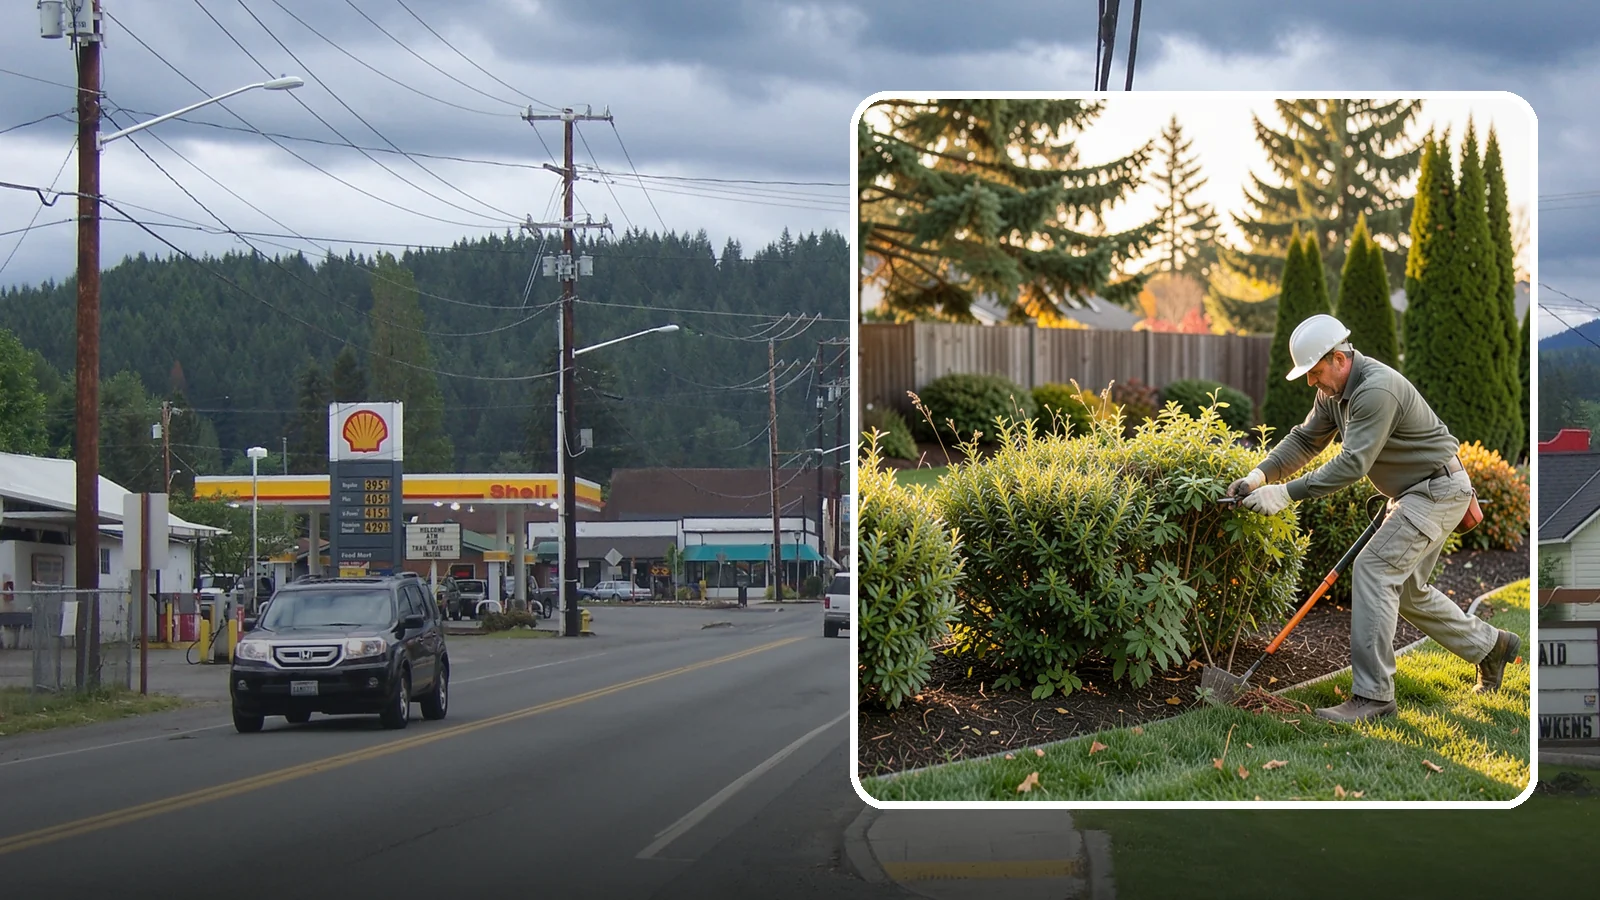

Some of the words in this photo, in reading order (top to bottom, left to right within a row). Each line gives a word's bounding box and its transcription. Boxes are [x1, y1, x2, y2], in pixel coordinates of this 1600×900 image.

[366, 480, 383, 490] 395
[490, 484, 547, 499] Shell
[366, 494, 383, 504] 405
[366, 508, 383, 518] 415
[366, 522, 383, 533] 429
[1539, 643, 1566, 666] AID
[1538, 716, 1592, 739] WKENS
